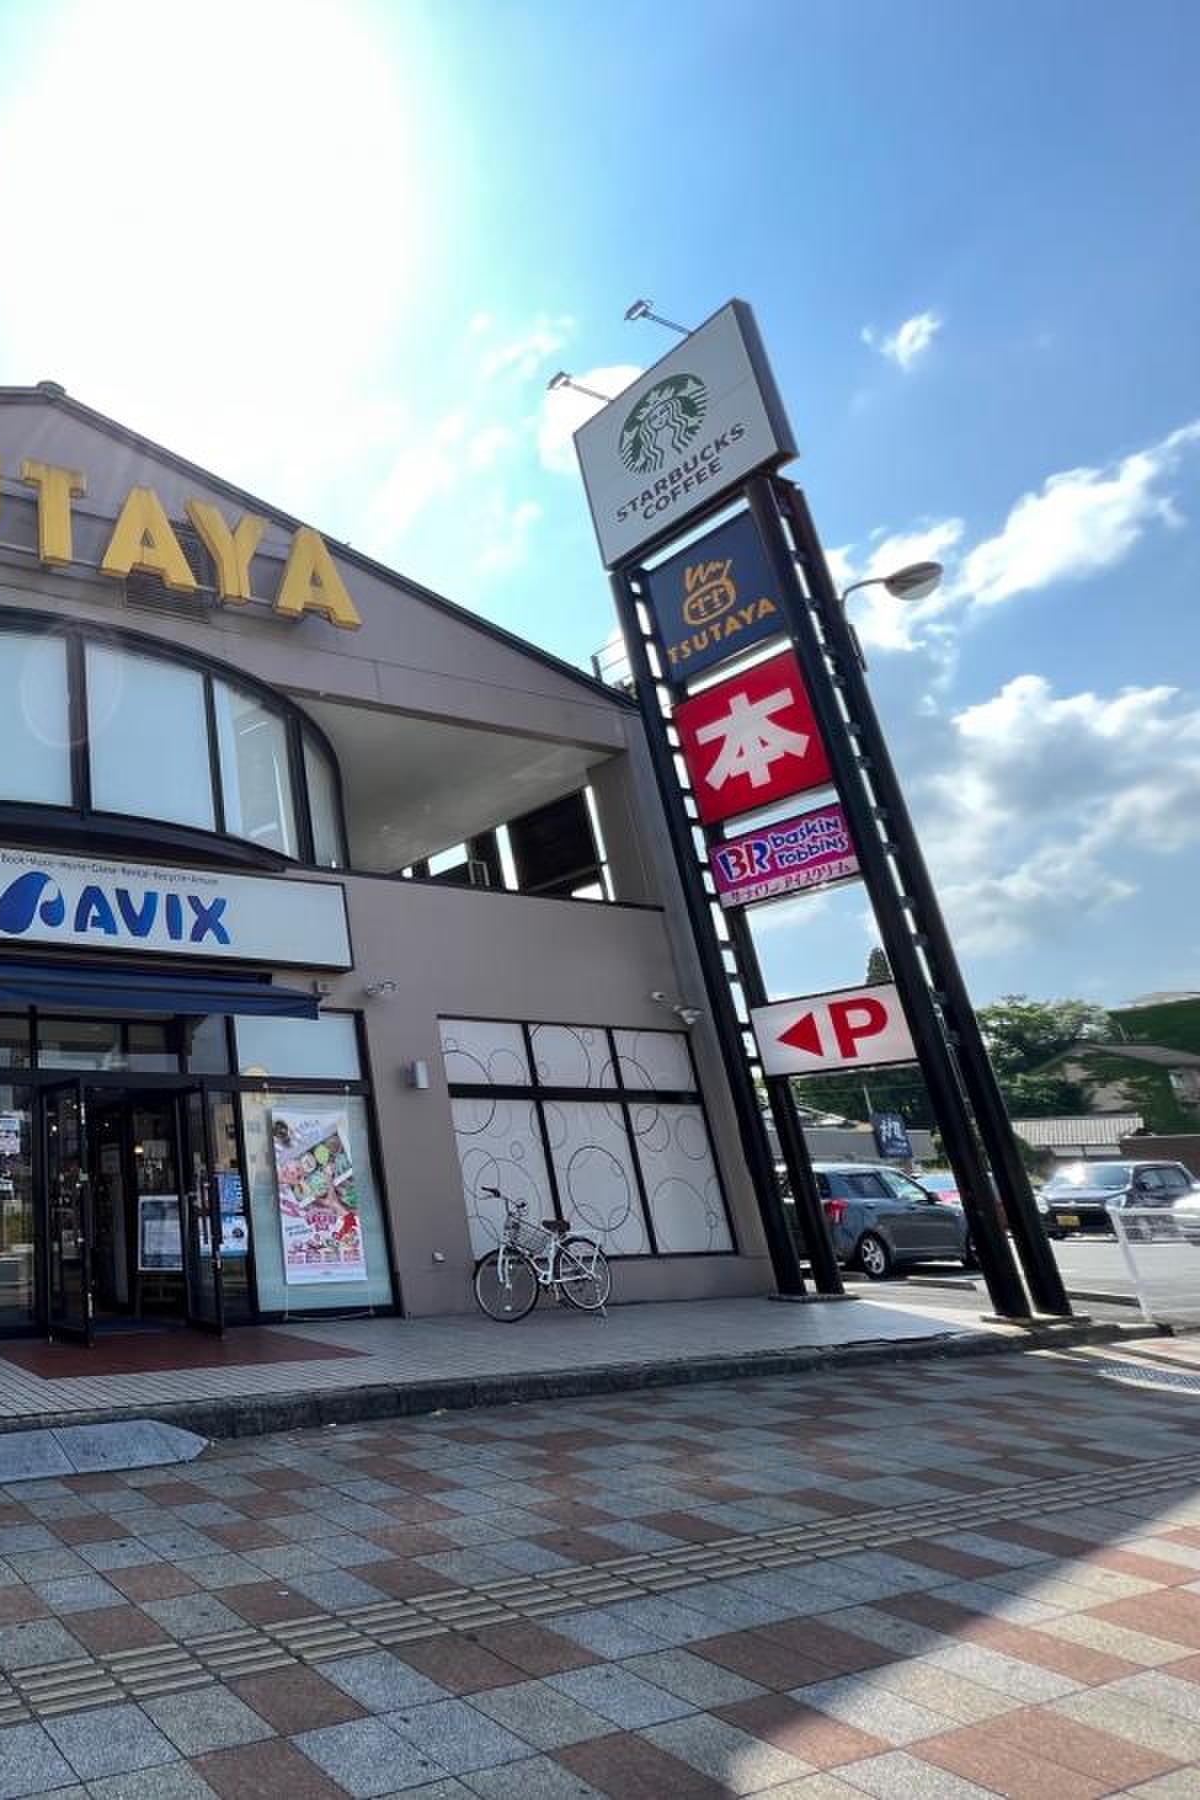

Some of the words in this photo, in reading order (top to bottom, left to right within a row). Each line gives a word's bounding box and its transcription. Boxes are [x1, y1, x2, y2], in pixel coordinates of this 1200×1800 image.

[614, 422, 745, 522] STARBUCKS
[642, 456, 723, 520] COFFEE
[667, 598, 777, 664] TSUTAYA
[696, 687, 810, 790] 本
[771, 818, 841, 847] baskin
[778, 834, 848, 866] robbins
[74, 885, 231, 945] AVIX
[827, 996, 887, 1057] P
